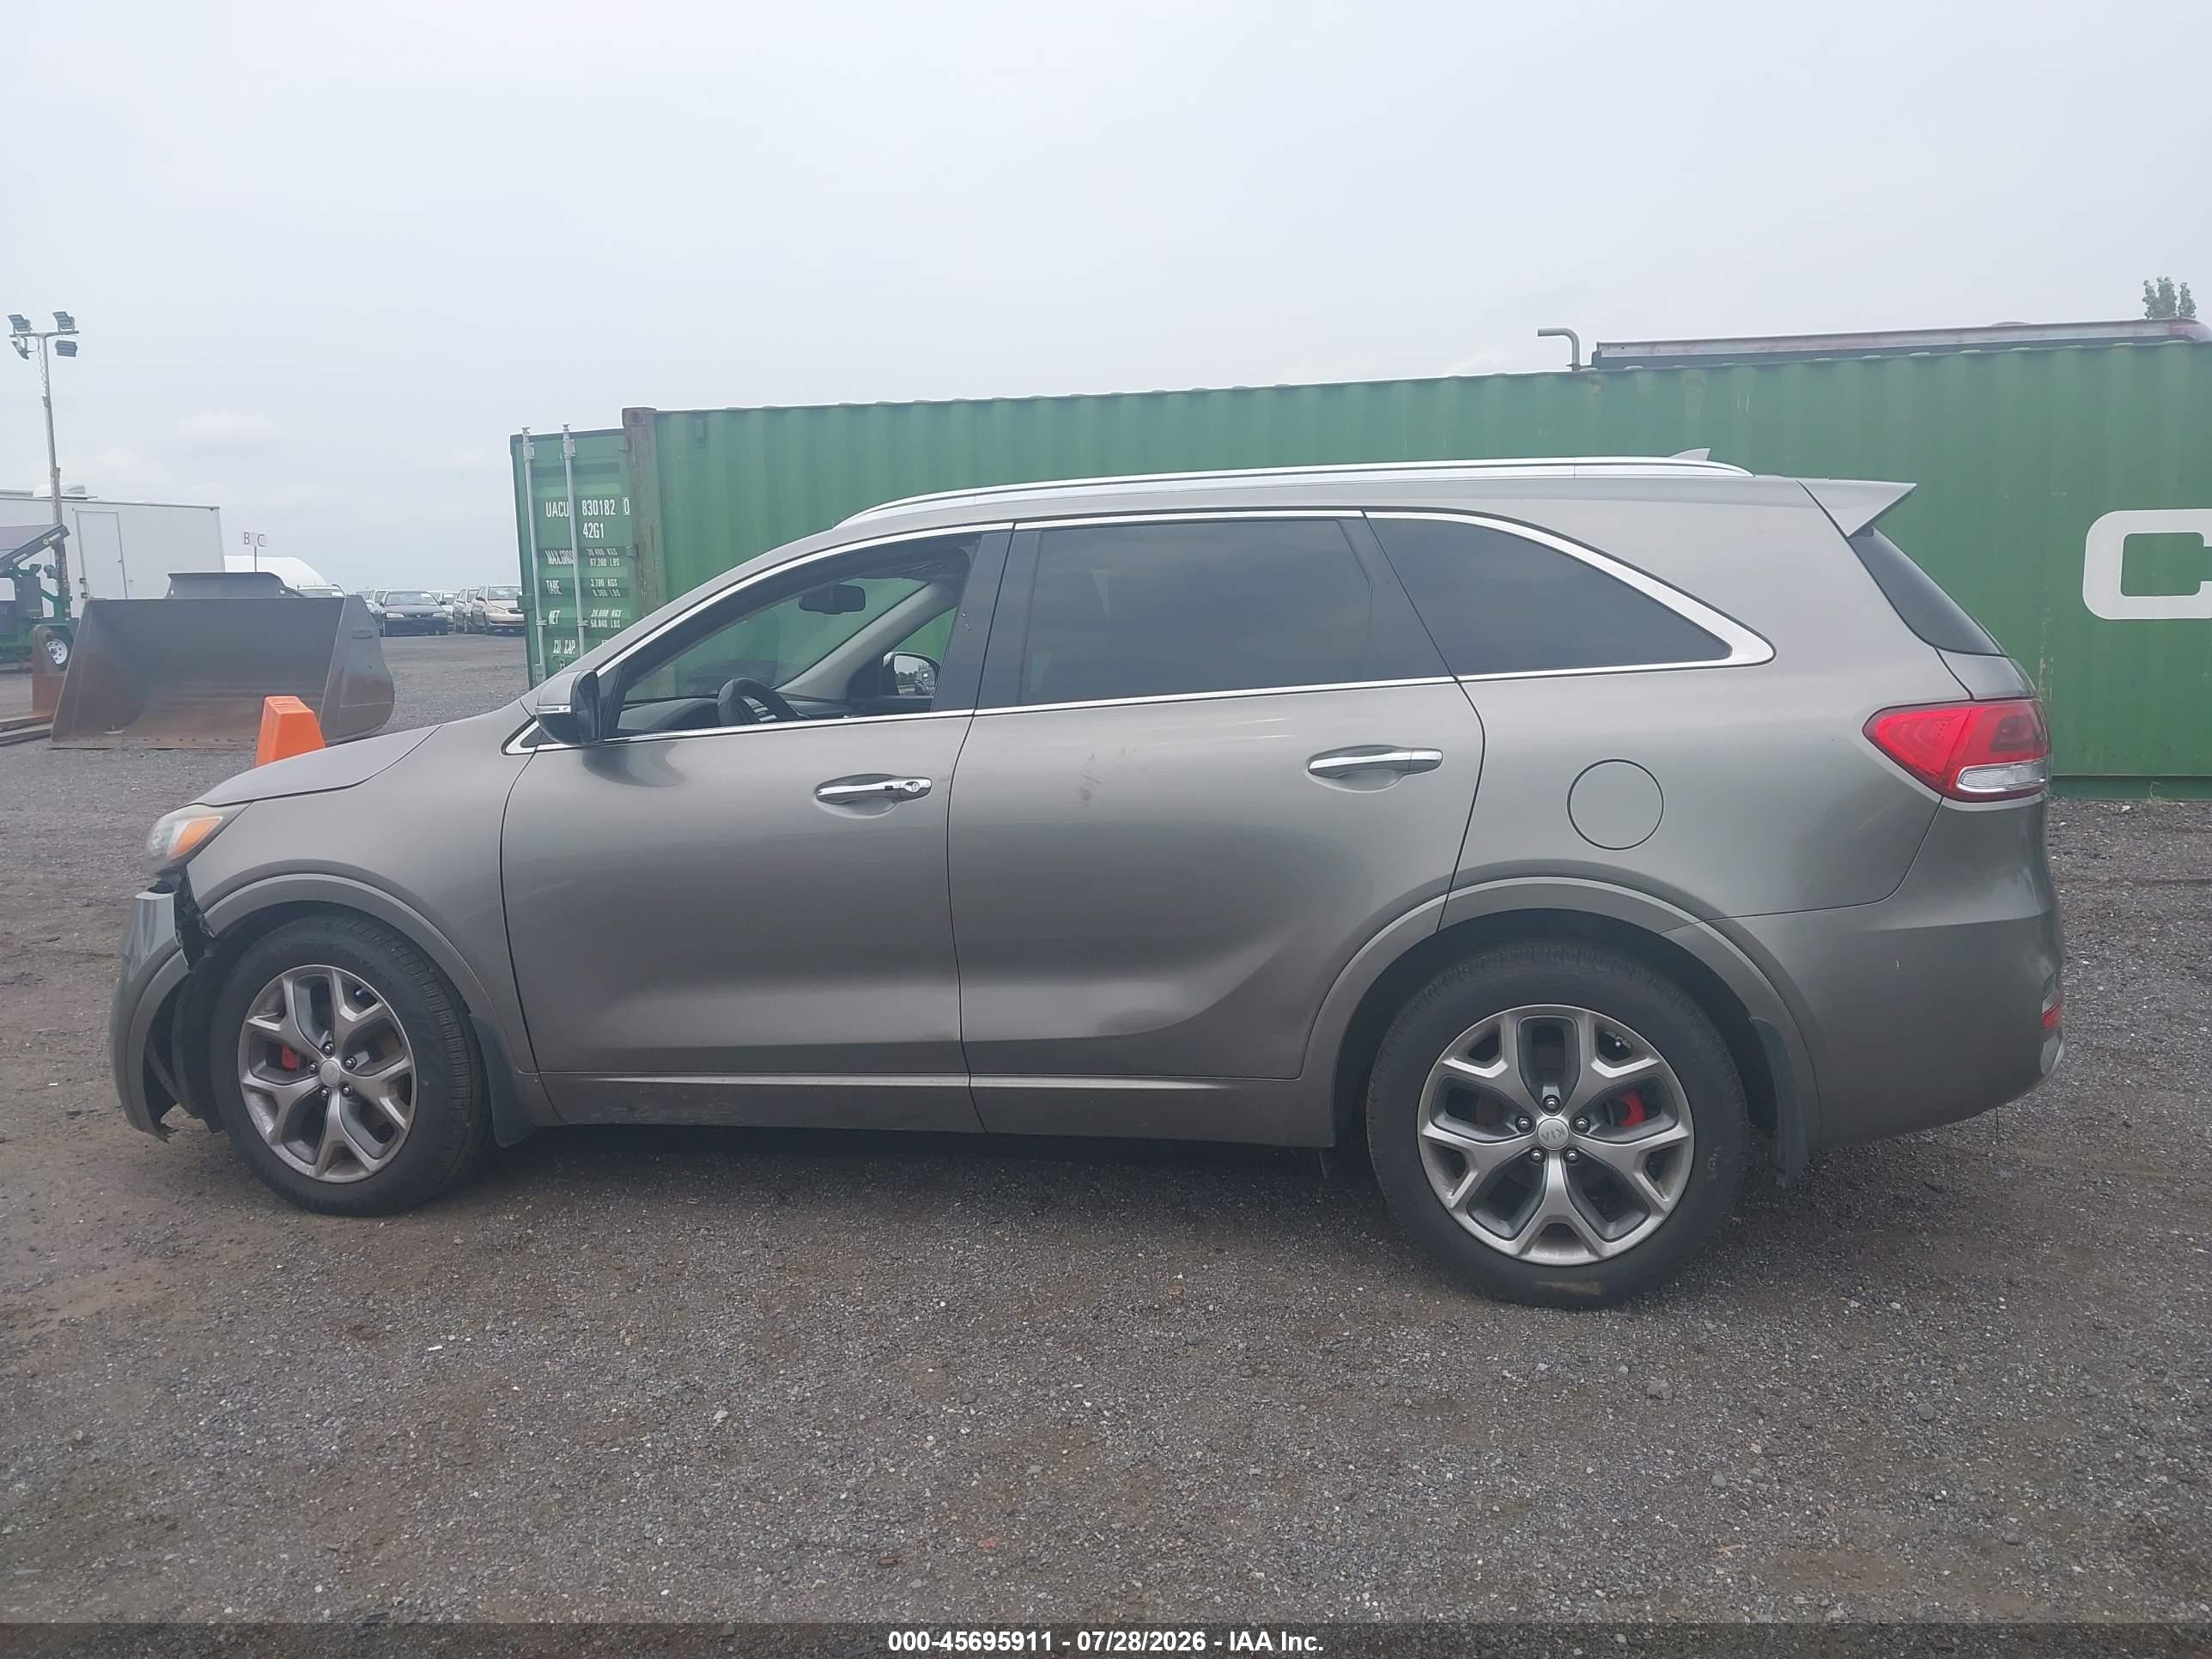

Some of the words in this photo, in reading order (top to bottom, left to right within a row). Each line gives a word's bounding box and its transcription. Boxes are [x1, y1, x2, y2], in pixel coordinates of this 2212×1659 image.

[545, 501, 569, 517] UACU
[581, 499, 616, 516] 830182
[582, 522, 605, 539] 42G1
[243, 532, 250, 545] B
[257, 533, 265, 547] C
[610, 557, 620, 567] LBS
[607, 578, 617, 587] KGS
[549, 610, 561, 625] NET
[611, 609, 622, 617] KGS
[611, 619, 621, 629] LBS
[1540, 1127, 1566, 1141] KIA
